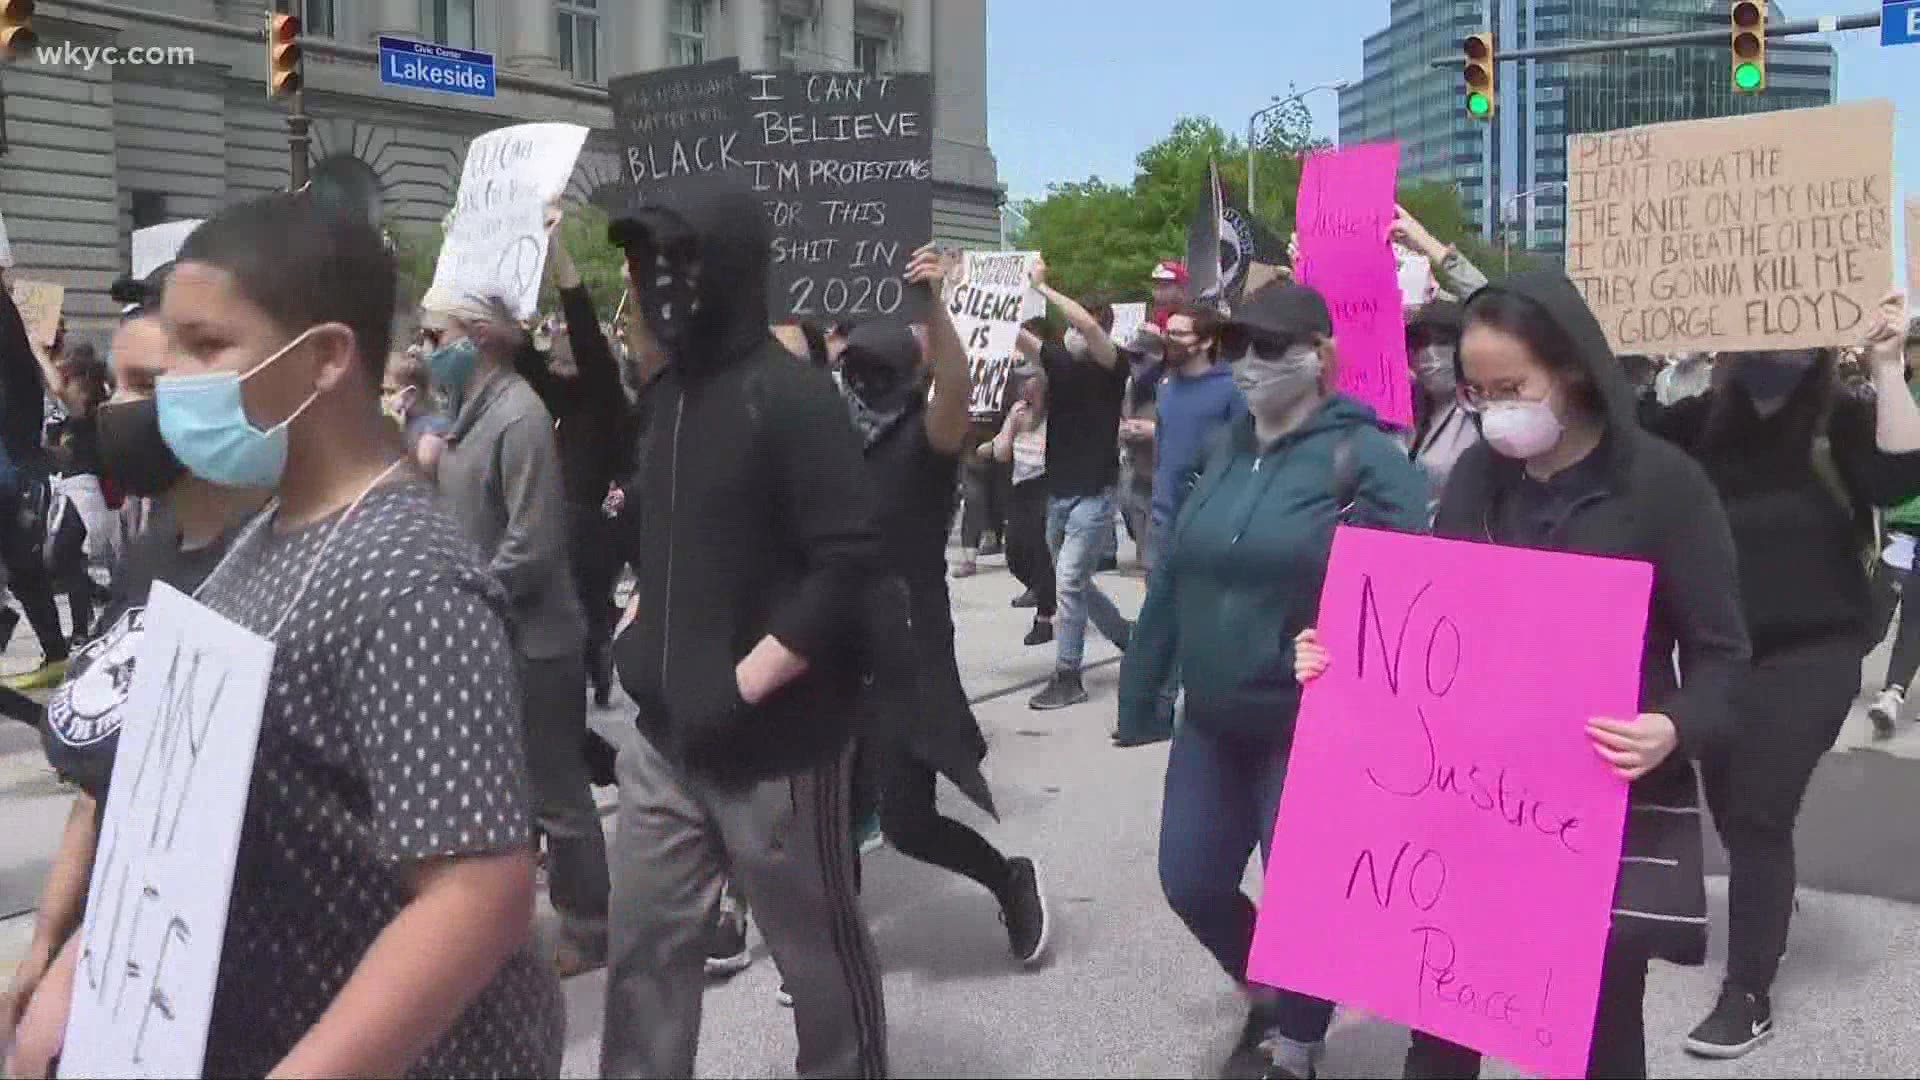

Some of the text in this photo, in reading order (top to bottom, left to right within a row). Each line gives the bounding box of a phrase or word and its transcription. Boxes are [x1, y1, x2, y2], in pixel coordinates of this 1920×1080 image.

[414, 43, 434, 54] Civic
[391, 54, 486, 90] Lakeside
[751, 75, 784, 100] I
[807, 75, 896, 103] CAN'T
[753, 111, 920, 145] BELIEVE
[628, 130, 745, 185] BLACK
[744, 158, 931, 191] I'M PROTESTING
[1666, 148, 1782, 192] BREATHE
[818, 201, 887, 225] THIS
[1569, 174, 1881, 243] THE KNEE ON MY NECK
[770, 237, 898, 267] SHIT IN
[1570, 242, 1593, 272] I
[1661, 222, 1771, 266] BREATHE
[789, 276, 903, 314] 2020
[1580, 249, 1866, 306] THEY GONNA KILL ME
[950, 285, 1022, 321] SILENCE
[1617, 290, 1863, 345] GEORGE FLOYD
[969, 325, 990, 349] IS
[1365, 705, 1586, 853] Justice
